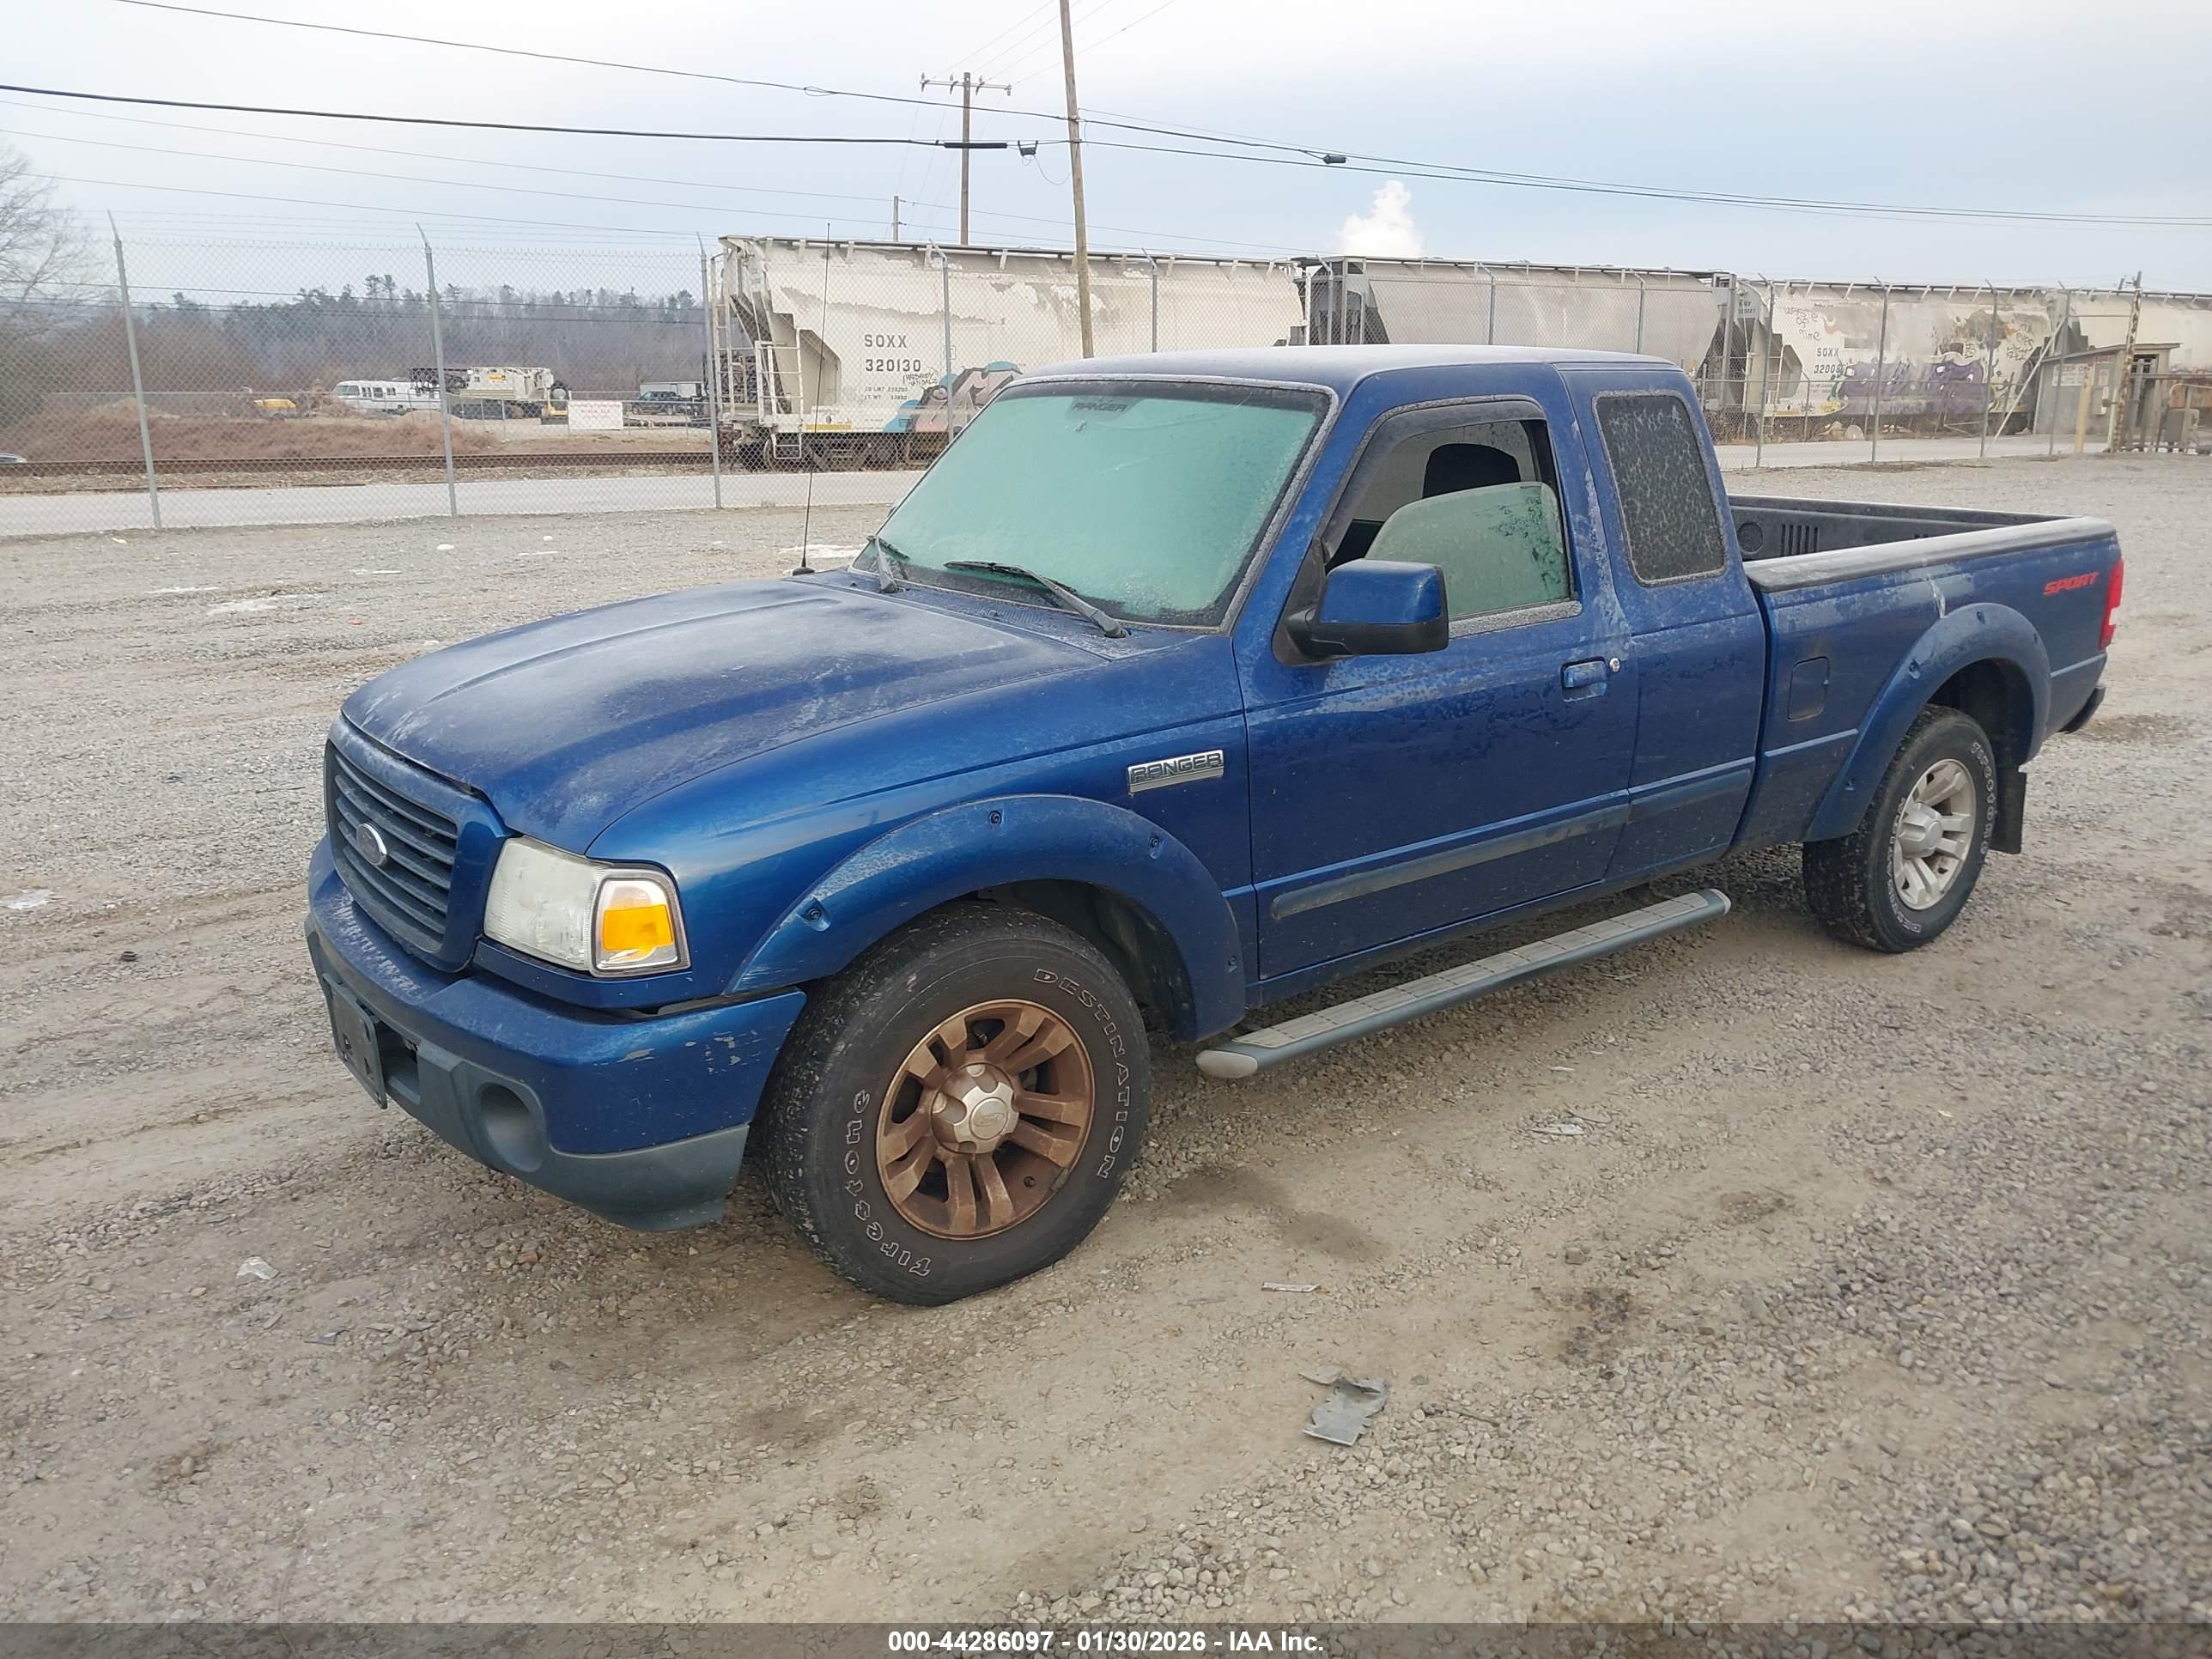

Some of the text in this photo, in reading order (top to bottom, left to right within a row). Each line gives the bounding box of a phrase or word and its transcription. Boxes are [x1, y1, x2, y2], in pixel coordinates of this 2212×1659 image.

[864, 334, 907, 348] SOXX
[1816, 347, 1839, 358] SOXX
[866, 359, 921, 372] 320130
[1071, 401, 1127, 413] RANGER
[2043, 572, 2099, 595] SPORT
[1130, 752, 1222, 784] RANGER
[1032, 968, 1132, 1181] DESTINATION
